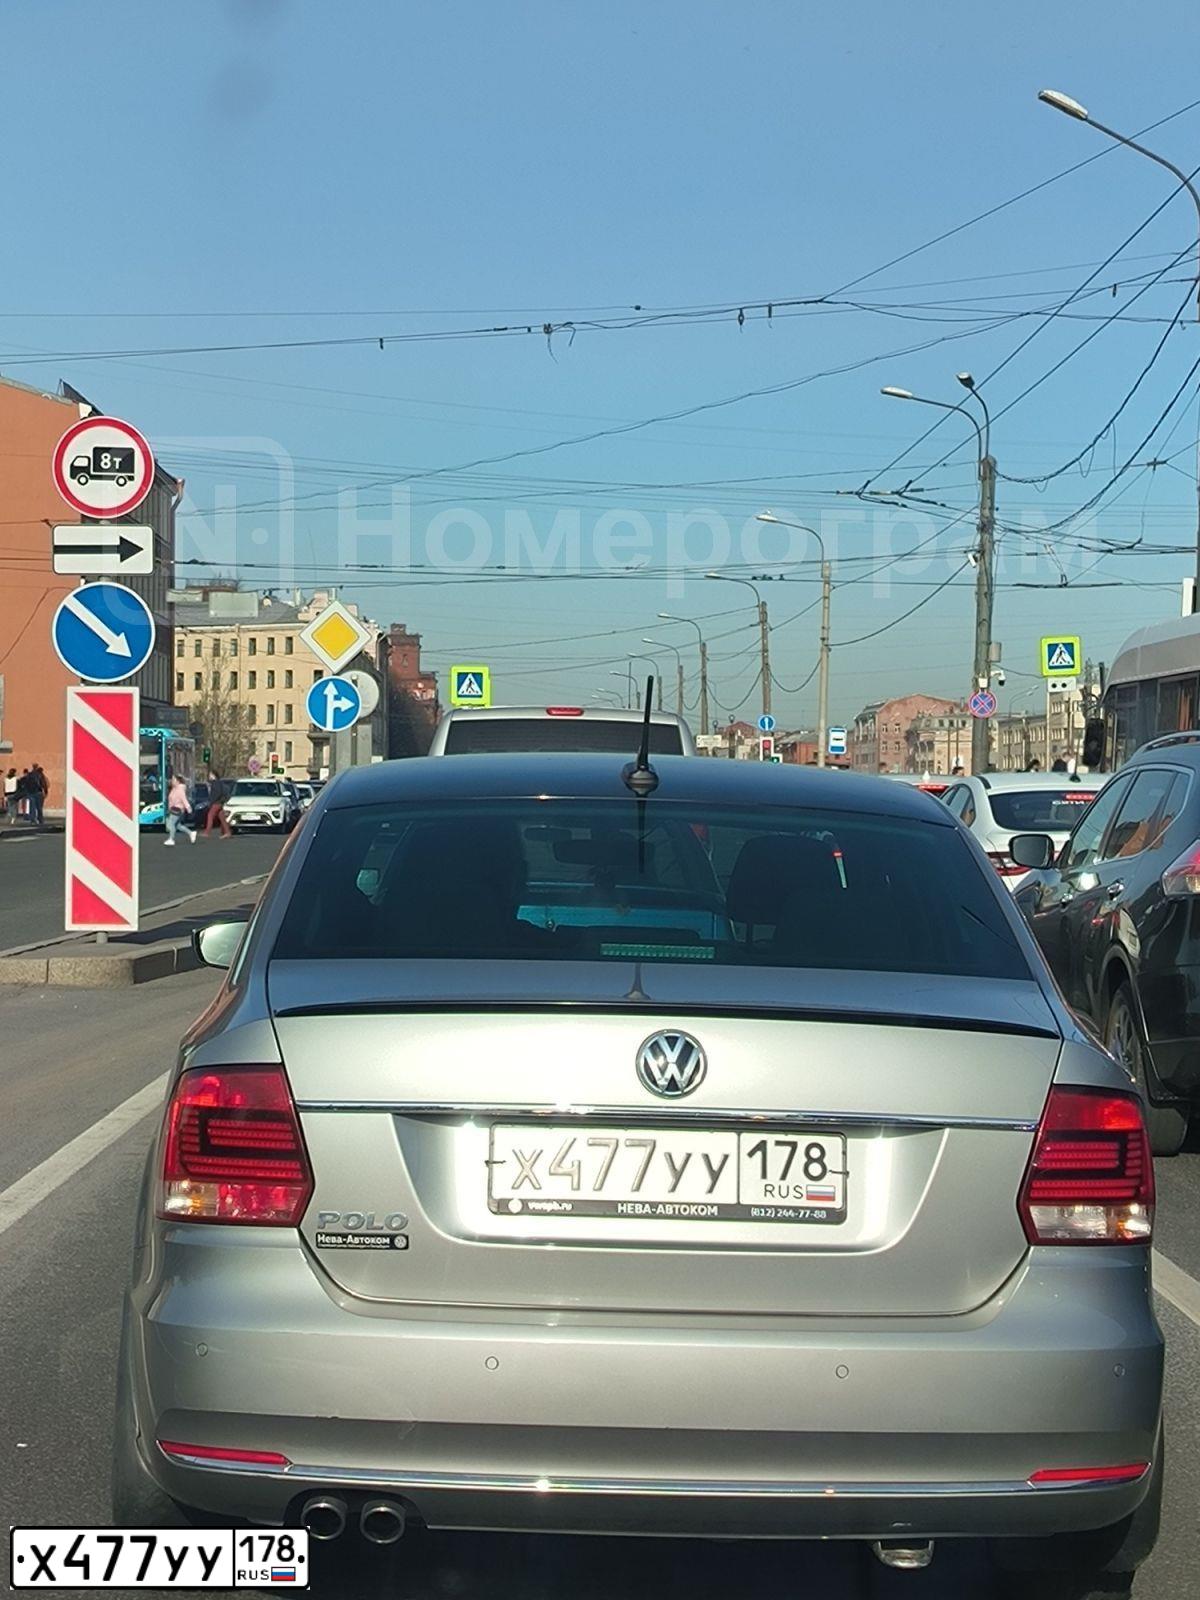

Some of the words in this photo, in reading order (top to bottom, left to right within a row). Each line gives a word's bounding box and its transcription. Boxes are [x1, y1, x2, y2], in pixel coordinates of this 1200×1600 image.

[747, 1139, 827, 1182] 178
[764, 1183, 803, 1199] RUS
[617, 1202, 718, 1216] НЕВА-АВТОКОМ
[751, 1207, 775, 1218] (812)
[317, 1210, 409, 1231] POLO
[317, 1234, 390, 1244] Нева-Автоком
